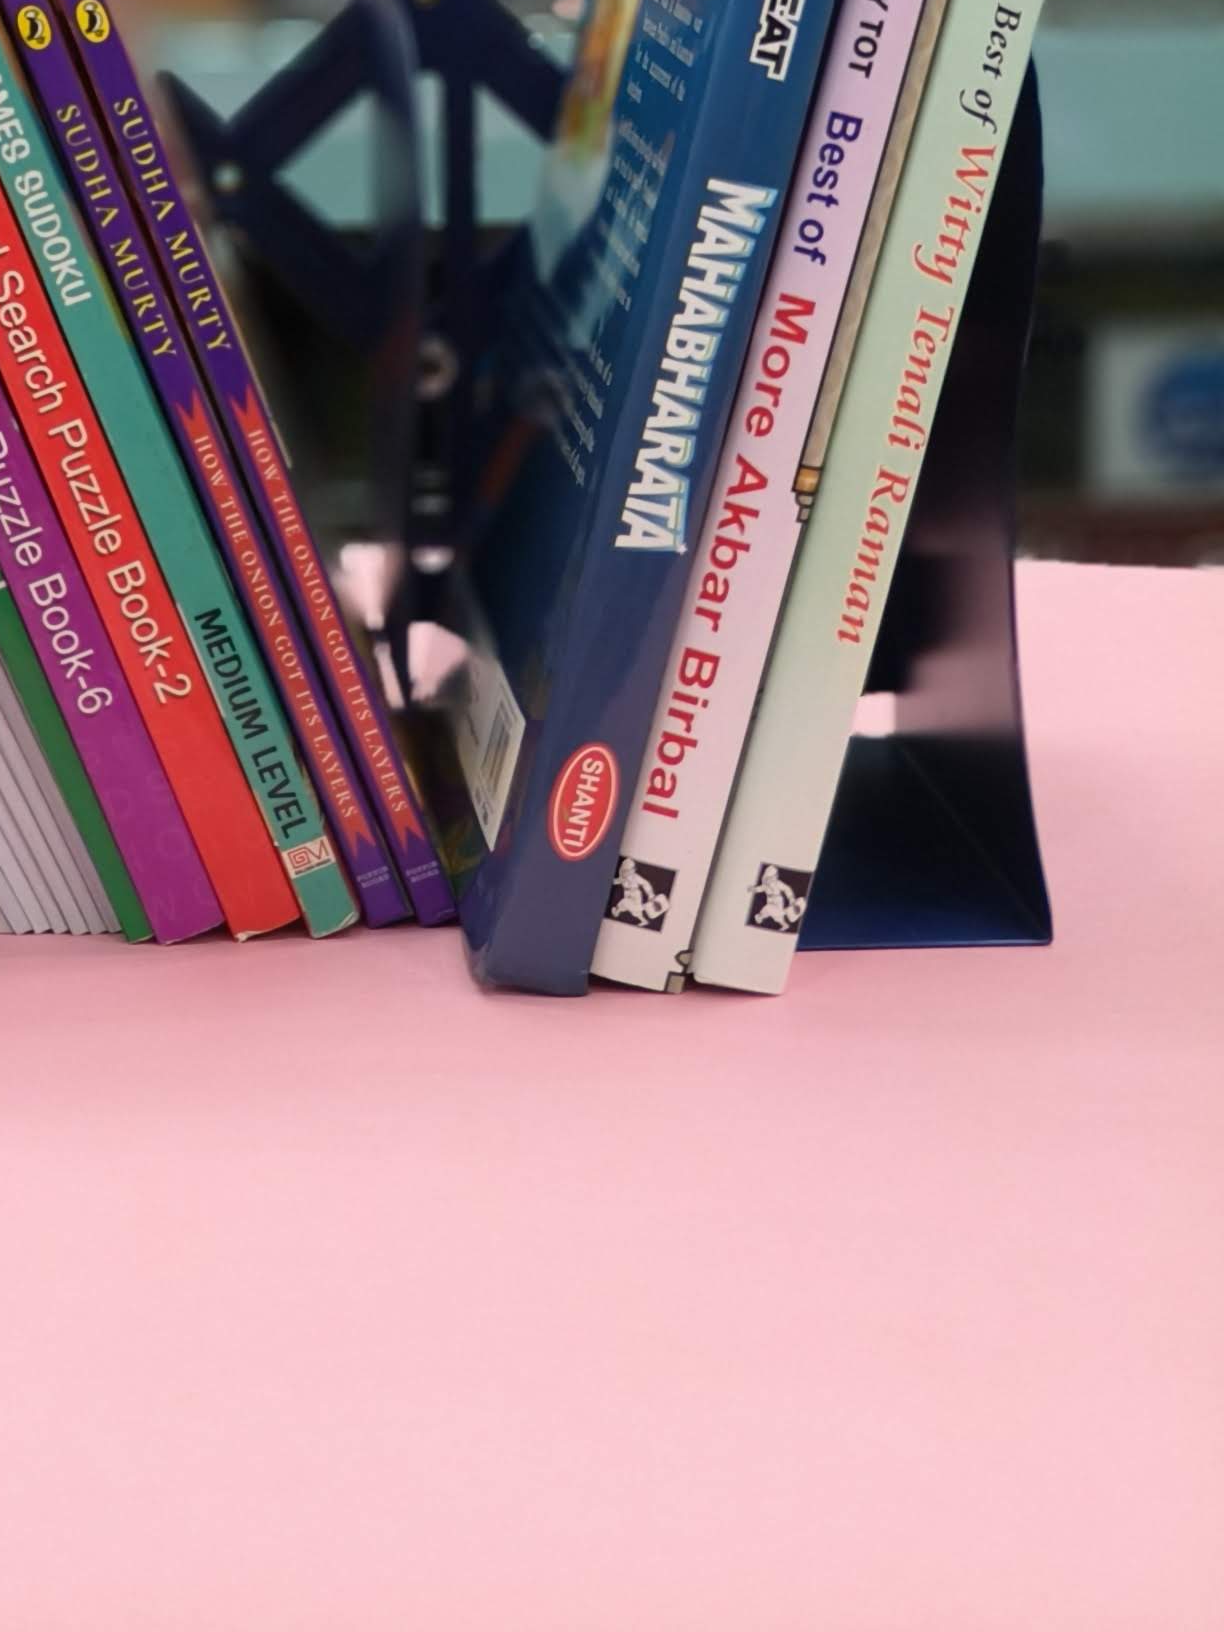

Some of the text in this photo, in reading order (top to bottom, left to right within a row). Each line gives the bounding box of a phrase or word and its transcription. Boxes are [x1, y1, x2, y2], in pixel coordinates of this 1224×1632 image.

[848, 18, 884, 79] TOT
[15, 170, 92, 307] SUDOKU
[56, 105, 177, 359] SUDHA MURTY
[114, 97, 231, 352] SUDHA MURTY
[793, 218, 826, 266] of
[806, 112, 864, 208] Best
[614, 178, 778, 554] MAHABHARATA
[744, 293, 817, 438] More
[837, 3, 1022, 645] Best of Witty Tenali Raman
[47, 418, 122, 556] Puzzle
[107, 559, 192, 705] Book-2
[195, 435, 357, 819] HOW THE ONION GOT ITS LAYERS
[248, 430, 280, 483] HOW
[274, 490, 303, 539] THE
[292, 544, 333, 622] ONION
[325, 629, 355, 676] GOT
[364, 728, 409, 814] LAYERS
[695, 454, 769, 633] Akbar
[28, 573, 113, 715] Book-6
[194, 607, 306, 838] MEDIUM LEVEL
[642, 647, 721, 820] Birbal
[560, 757, 604, 849] SHANTI
